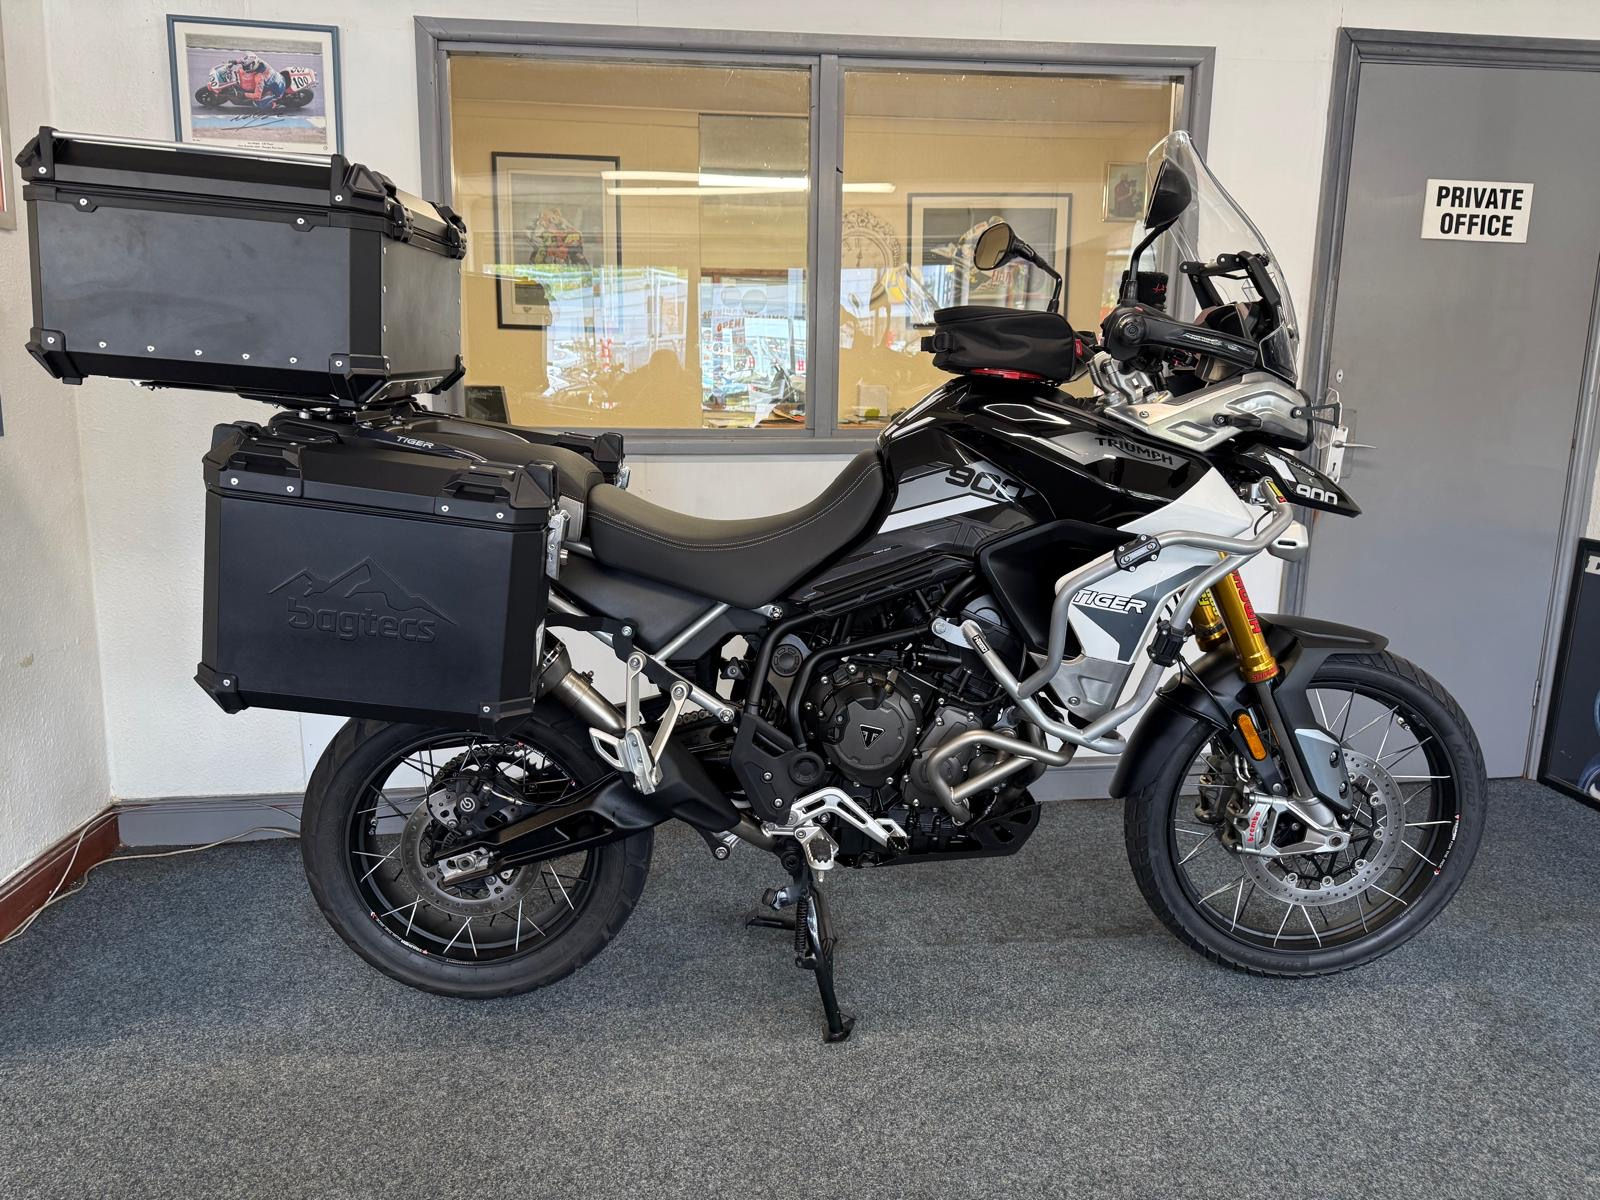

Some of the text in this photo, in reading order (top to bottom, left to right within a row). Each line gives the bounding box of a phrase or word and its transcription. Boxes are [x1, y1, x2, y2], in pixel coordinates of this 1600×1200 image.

[292, 75, 309, 89] 100
[1436, 185, 1524, 211] PRIVATE
[1439, 212, 1514, 237] OFFICE
[396, 435, 435, 449] TIGER
[1095, 437, 1173, 466] TRIUMPH
[945, 464, 1027, 500] 900
[1300, 465, 1316, 477] PRO
[1296, 483, 1338, 506] 900
[1071, 588, 1148, 615] TIGER
[1230, 567, 1262, 634] HOWA
[287, 596, 436, 643] bagtecs
[1247, 811, 1261, 842] brembo
